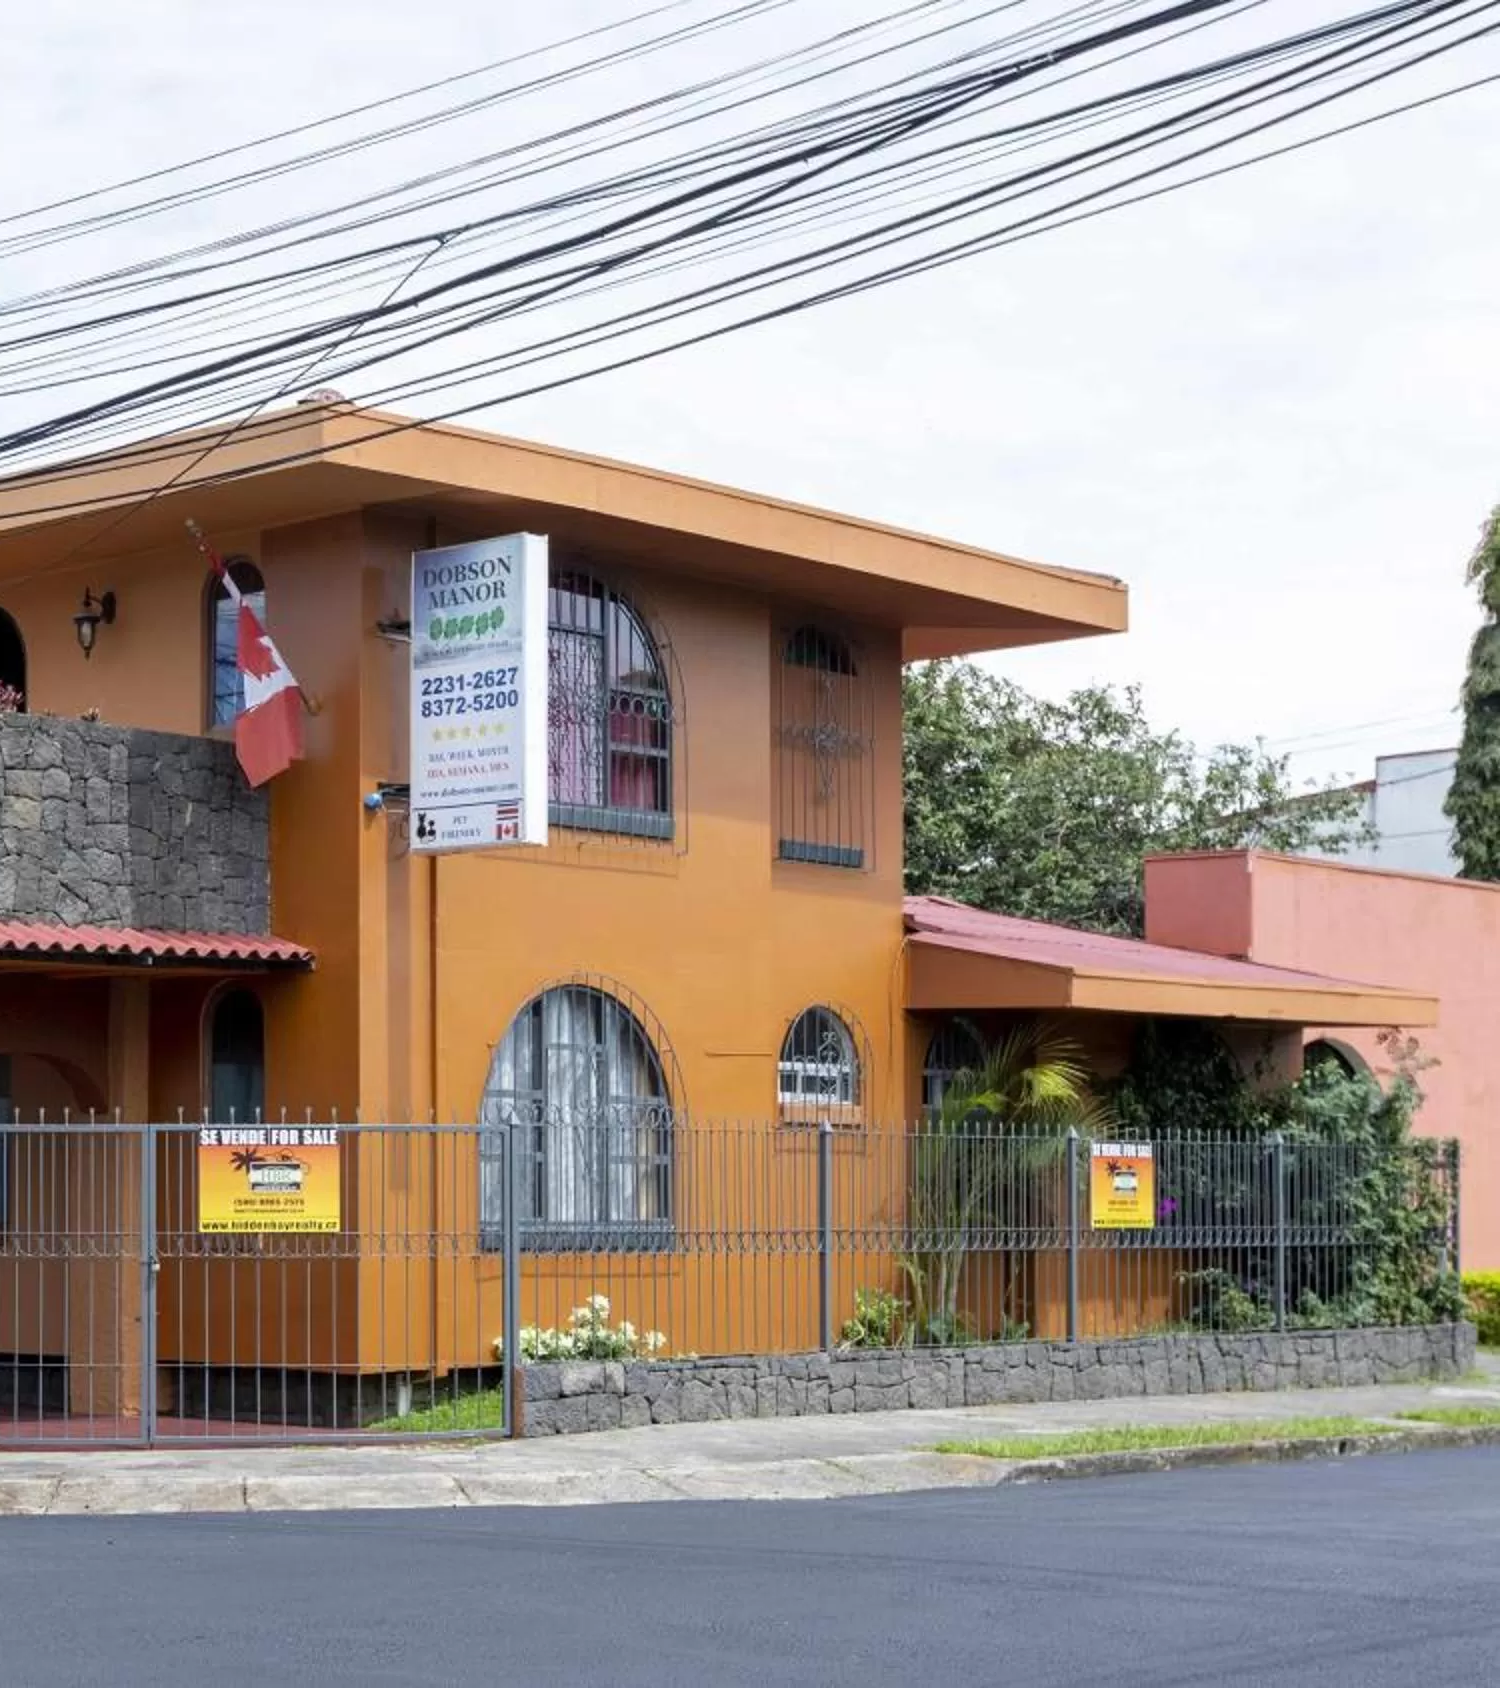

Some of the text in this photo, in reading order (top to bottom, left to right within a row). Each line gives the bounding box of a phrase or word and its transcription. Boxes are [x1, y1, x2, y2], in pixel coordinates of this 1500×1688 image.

[422, 555, 513, 588] DOBSON
[428, 579, 507, 610] MANOR
[421, 666, 519, 696] 2231-2627
[421, 690, 519, 718] 8372-5200
[200, 1129, 337, 1145] SE VENDE FOR SALE
